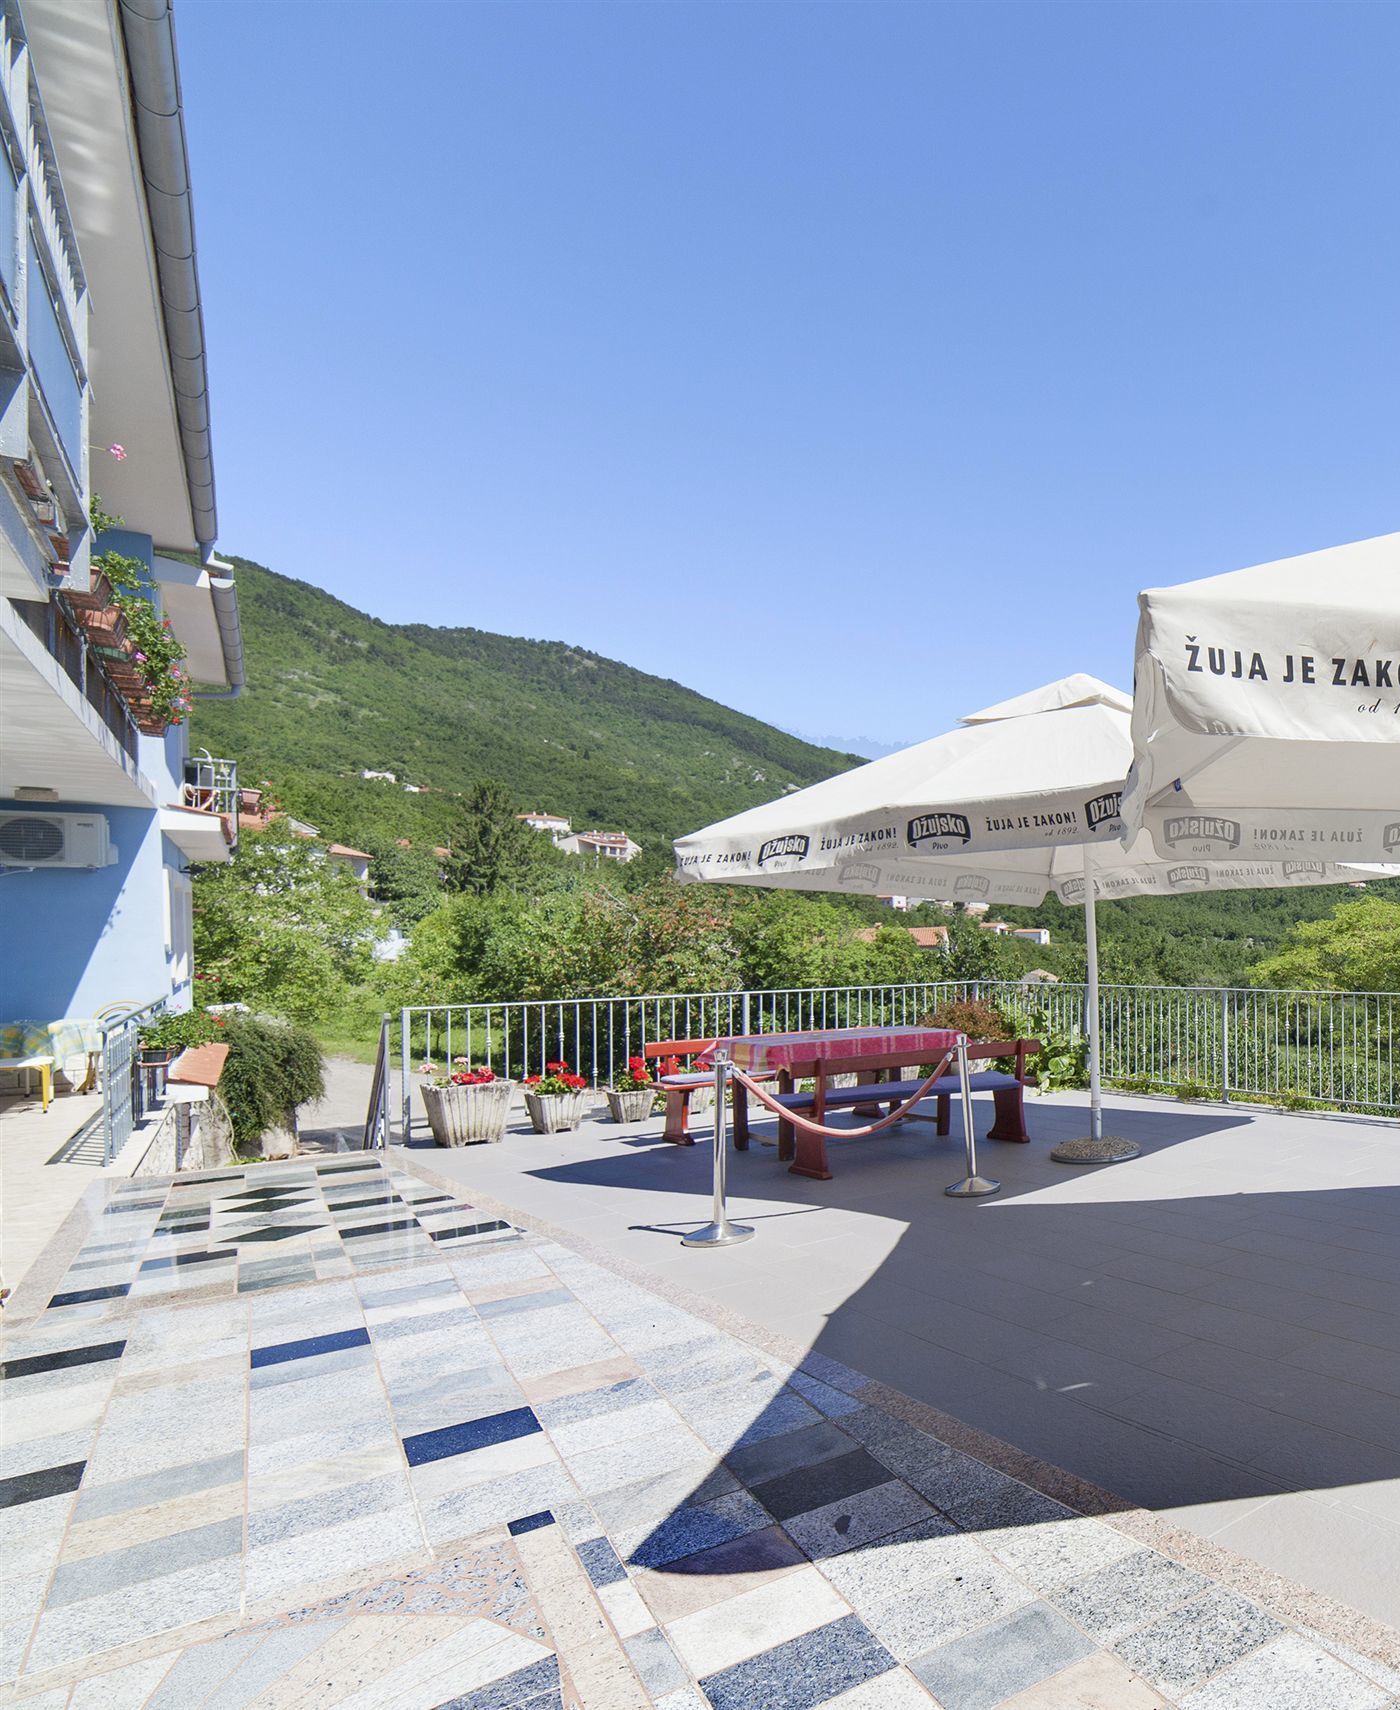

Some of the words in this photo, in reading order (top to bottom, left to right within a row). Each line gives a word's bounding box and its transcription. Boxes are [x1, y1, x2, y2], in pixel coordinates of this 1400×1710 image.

[1184, 635, 1268, 681] ŽUJA
[1283, 655, 1316, 684] JE
[1357, 698, 1382, 714] od
[912, 813, 966, 840] Ožujsko
[985, 816, 1014, 832] ŽUJA
[1018, 816, 1030, 828] JE
[1034, 811, 1077, 827] ZAKON!
[761, 837, 806, 860] Ožujsko
[820, 836, 843, 851] ŽUJA
[845, 835, 857, 847] JE
[858, 827, 897, 845] ZAKON!
[932, 841, 949, 851] Pivo
[700, 853, 712, 863] JE
[716, 850, 751, 863] ZAKON!
